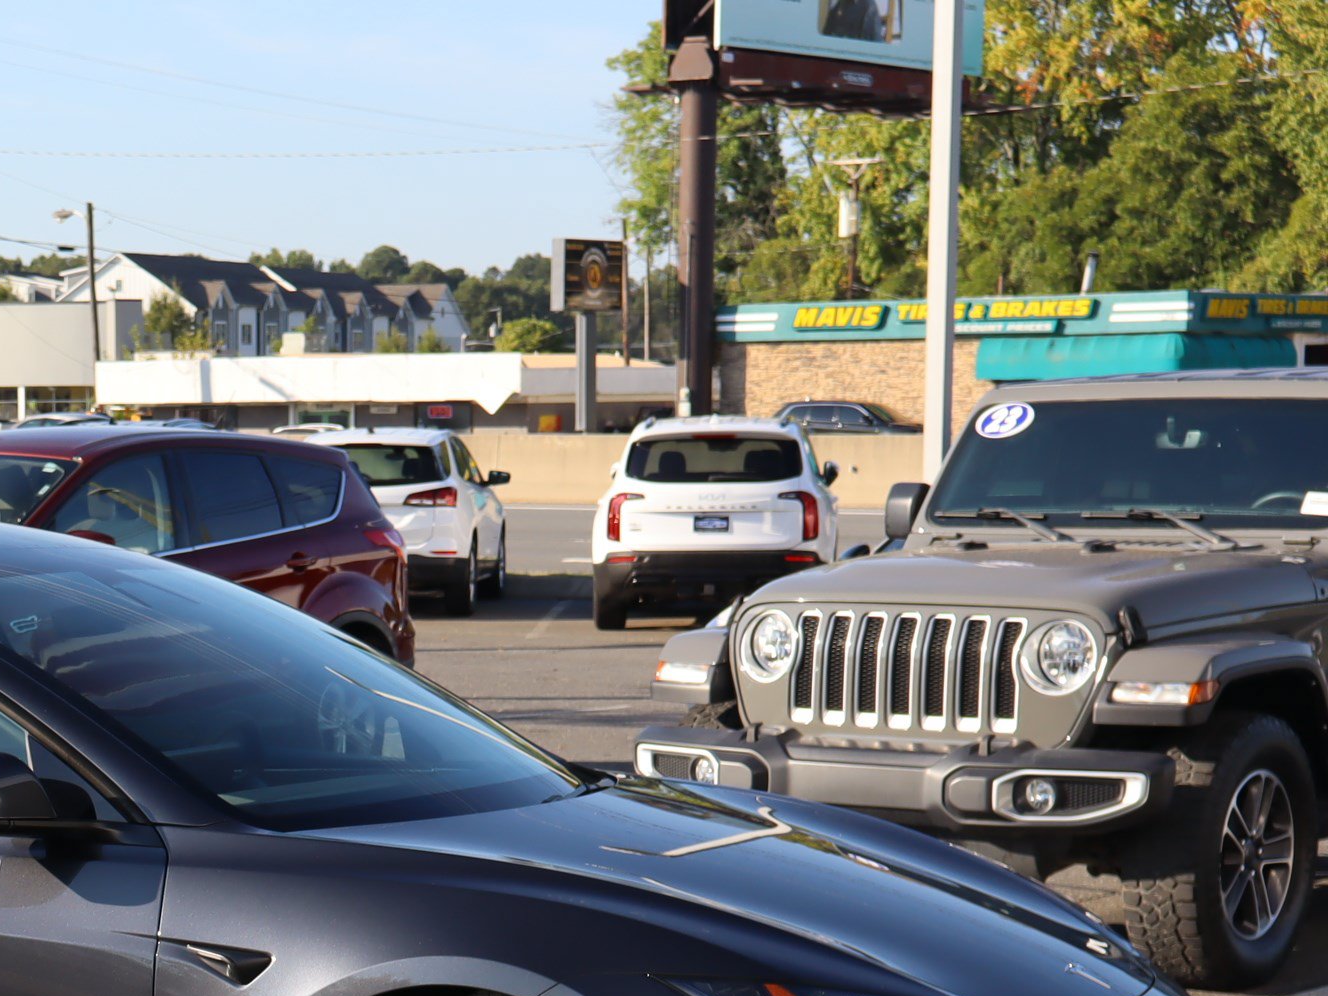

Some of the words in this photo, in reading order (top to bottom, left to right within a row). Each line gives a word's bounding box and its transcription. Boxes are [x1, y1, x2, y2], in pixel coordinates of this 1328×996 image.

[793, 305, 883, 328] MAVIS
[897, 302, 966, 320] TIRS
[969, 304, 985, 319] &
[989, 299, 1091, 318] BRAKES
